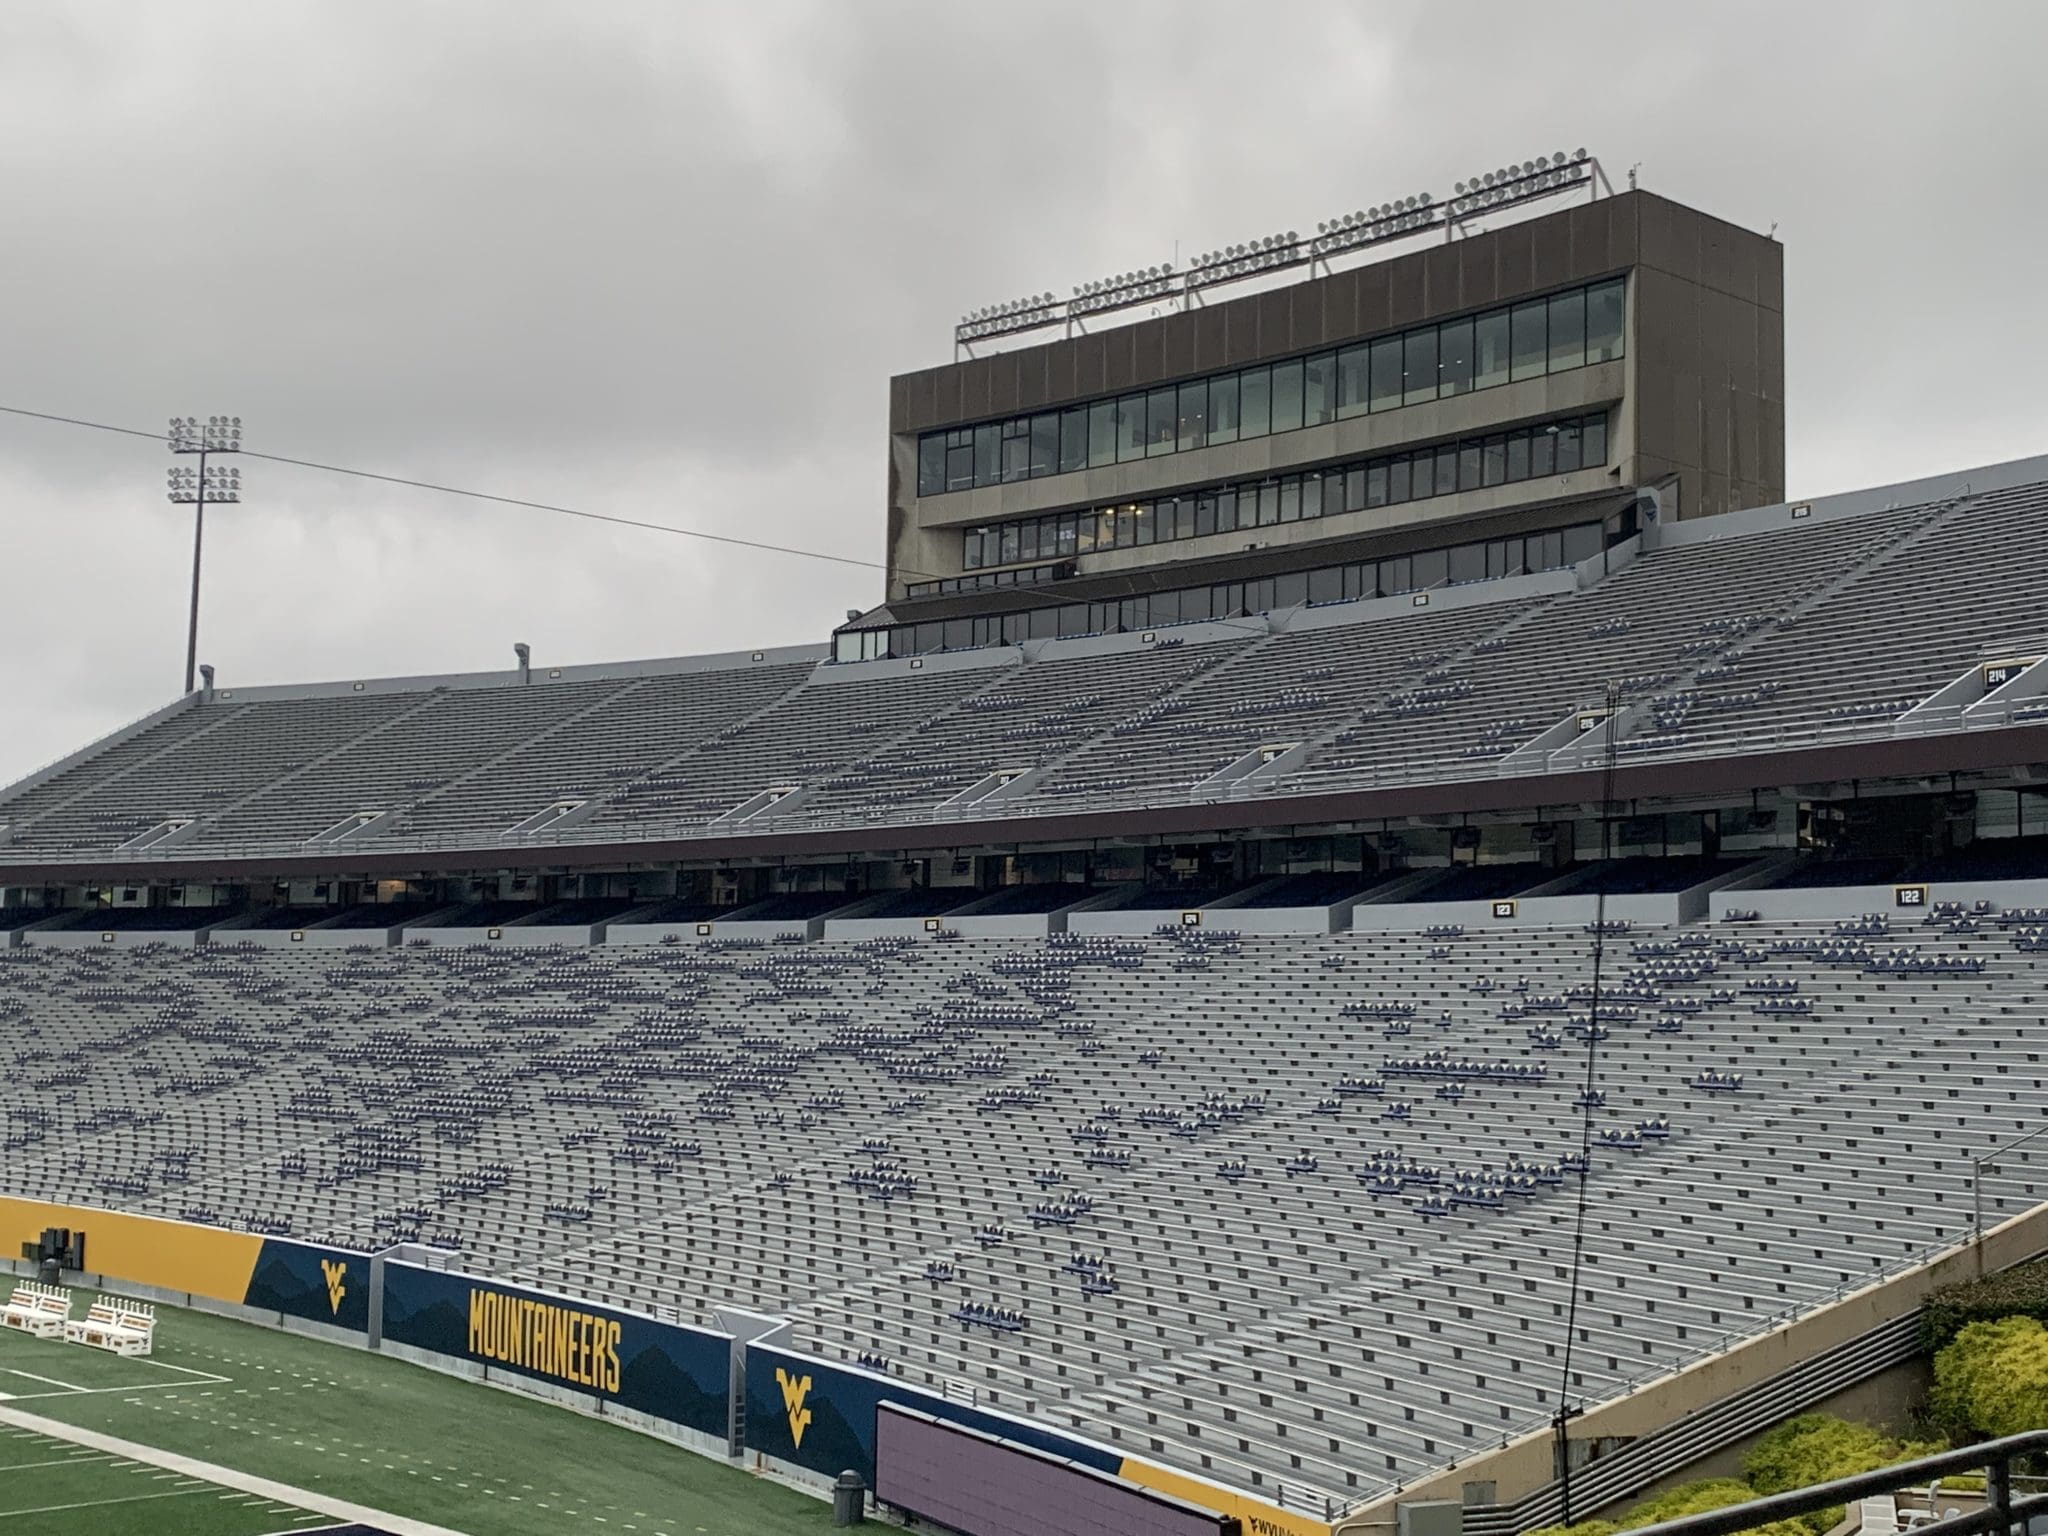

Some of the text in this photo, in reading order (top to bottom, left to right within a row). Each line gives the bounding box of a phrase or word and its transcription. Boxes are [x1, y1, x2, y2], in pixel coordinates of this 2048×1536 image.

[1988, 669, 2006, 683] 214
[1581, 718, 1594, 729] 215
[1901, 890, 1920, 904] 122
[1496, 904, 1511, 916] 123
[469, 1288, 621, 1394] MOUNTAINEERS
